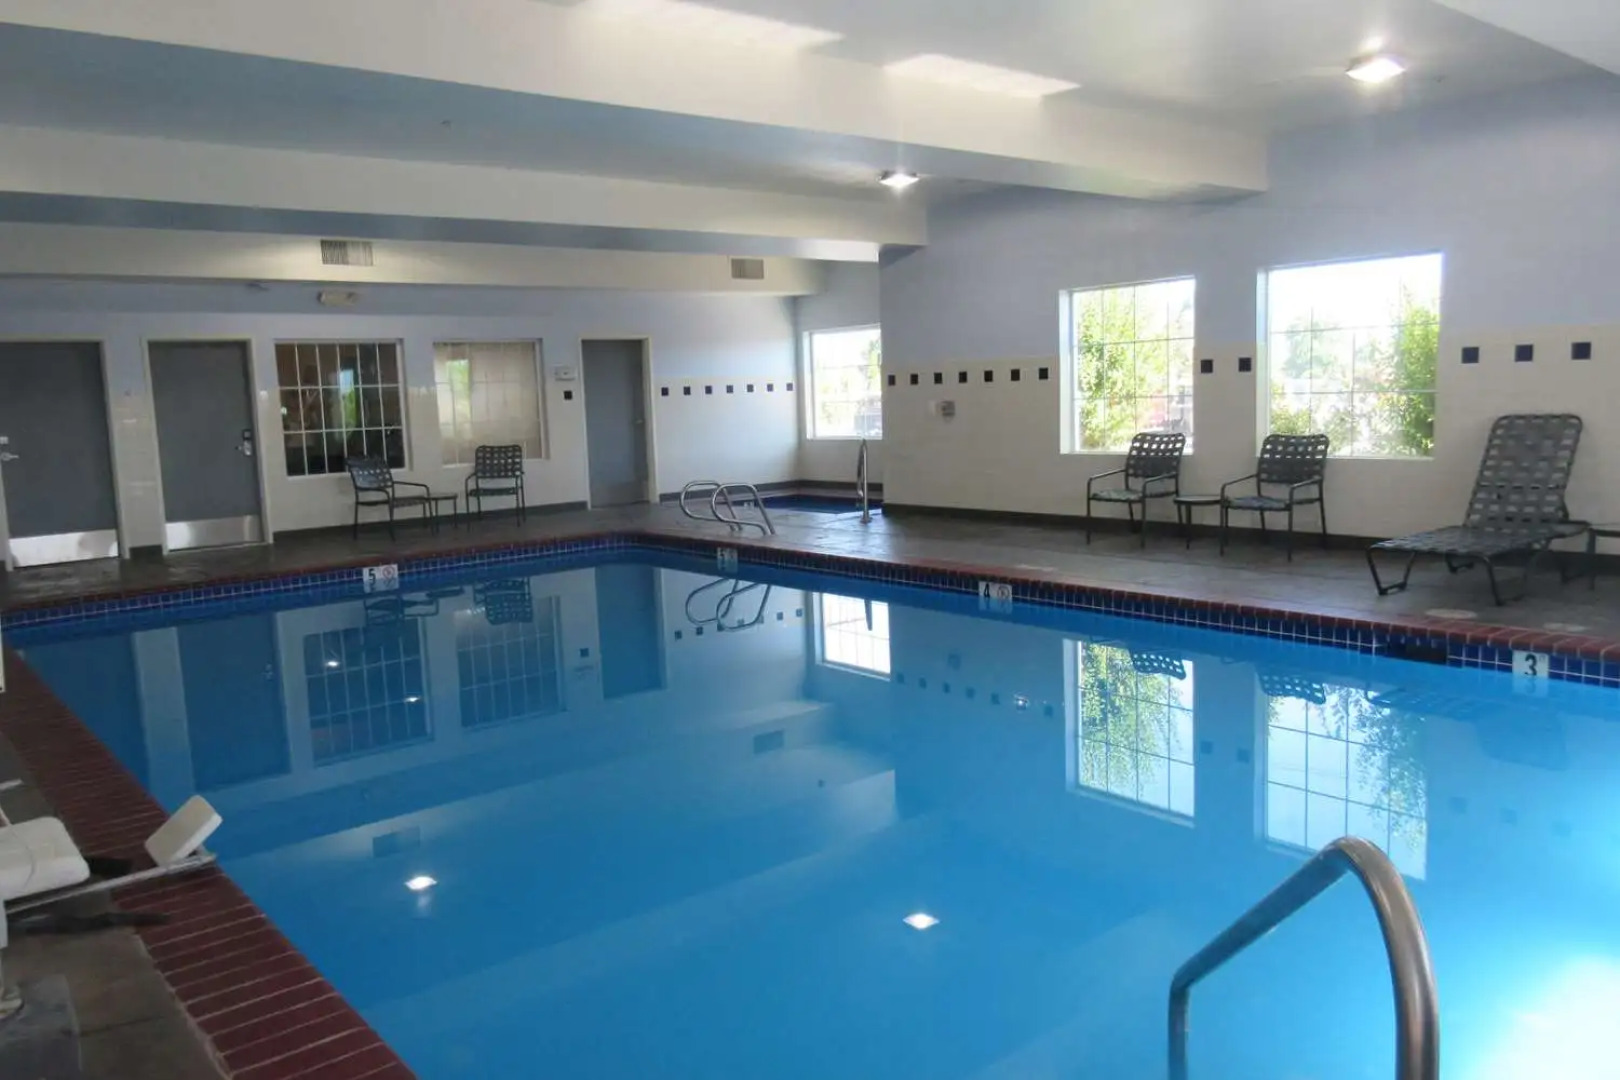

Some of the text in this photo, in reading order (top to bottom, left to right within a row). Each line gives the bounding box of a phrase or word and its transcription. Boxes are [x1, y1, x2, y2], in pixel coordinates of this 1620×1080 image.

[368, 568, 376, 582] 5
[983, 583, 991, 598] 4
[1524, 653, 1538, 676] 3
